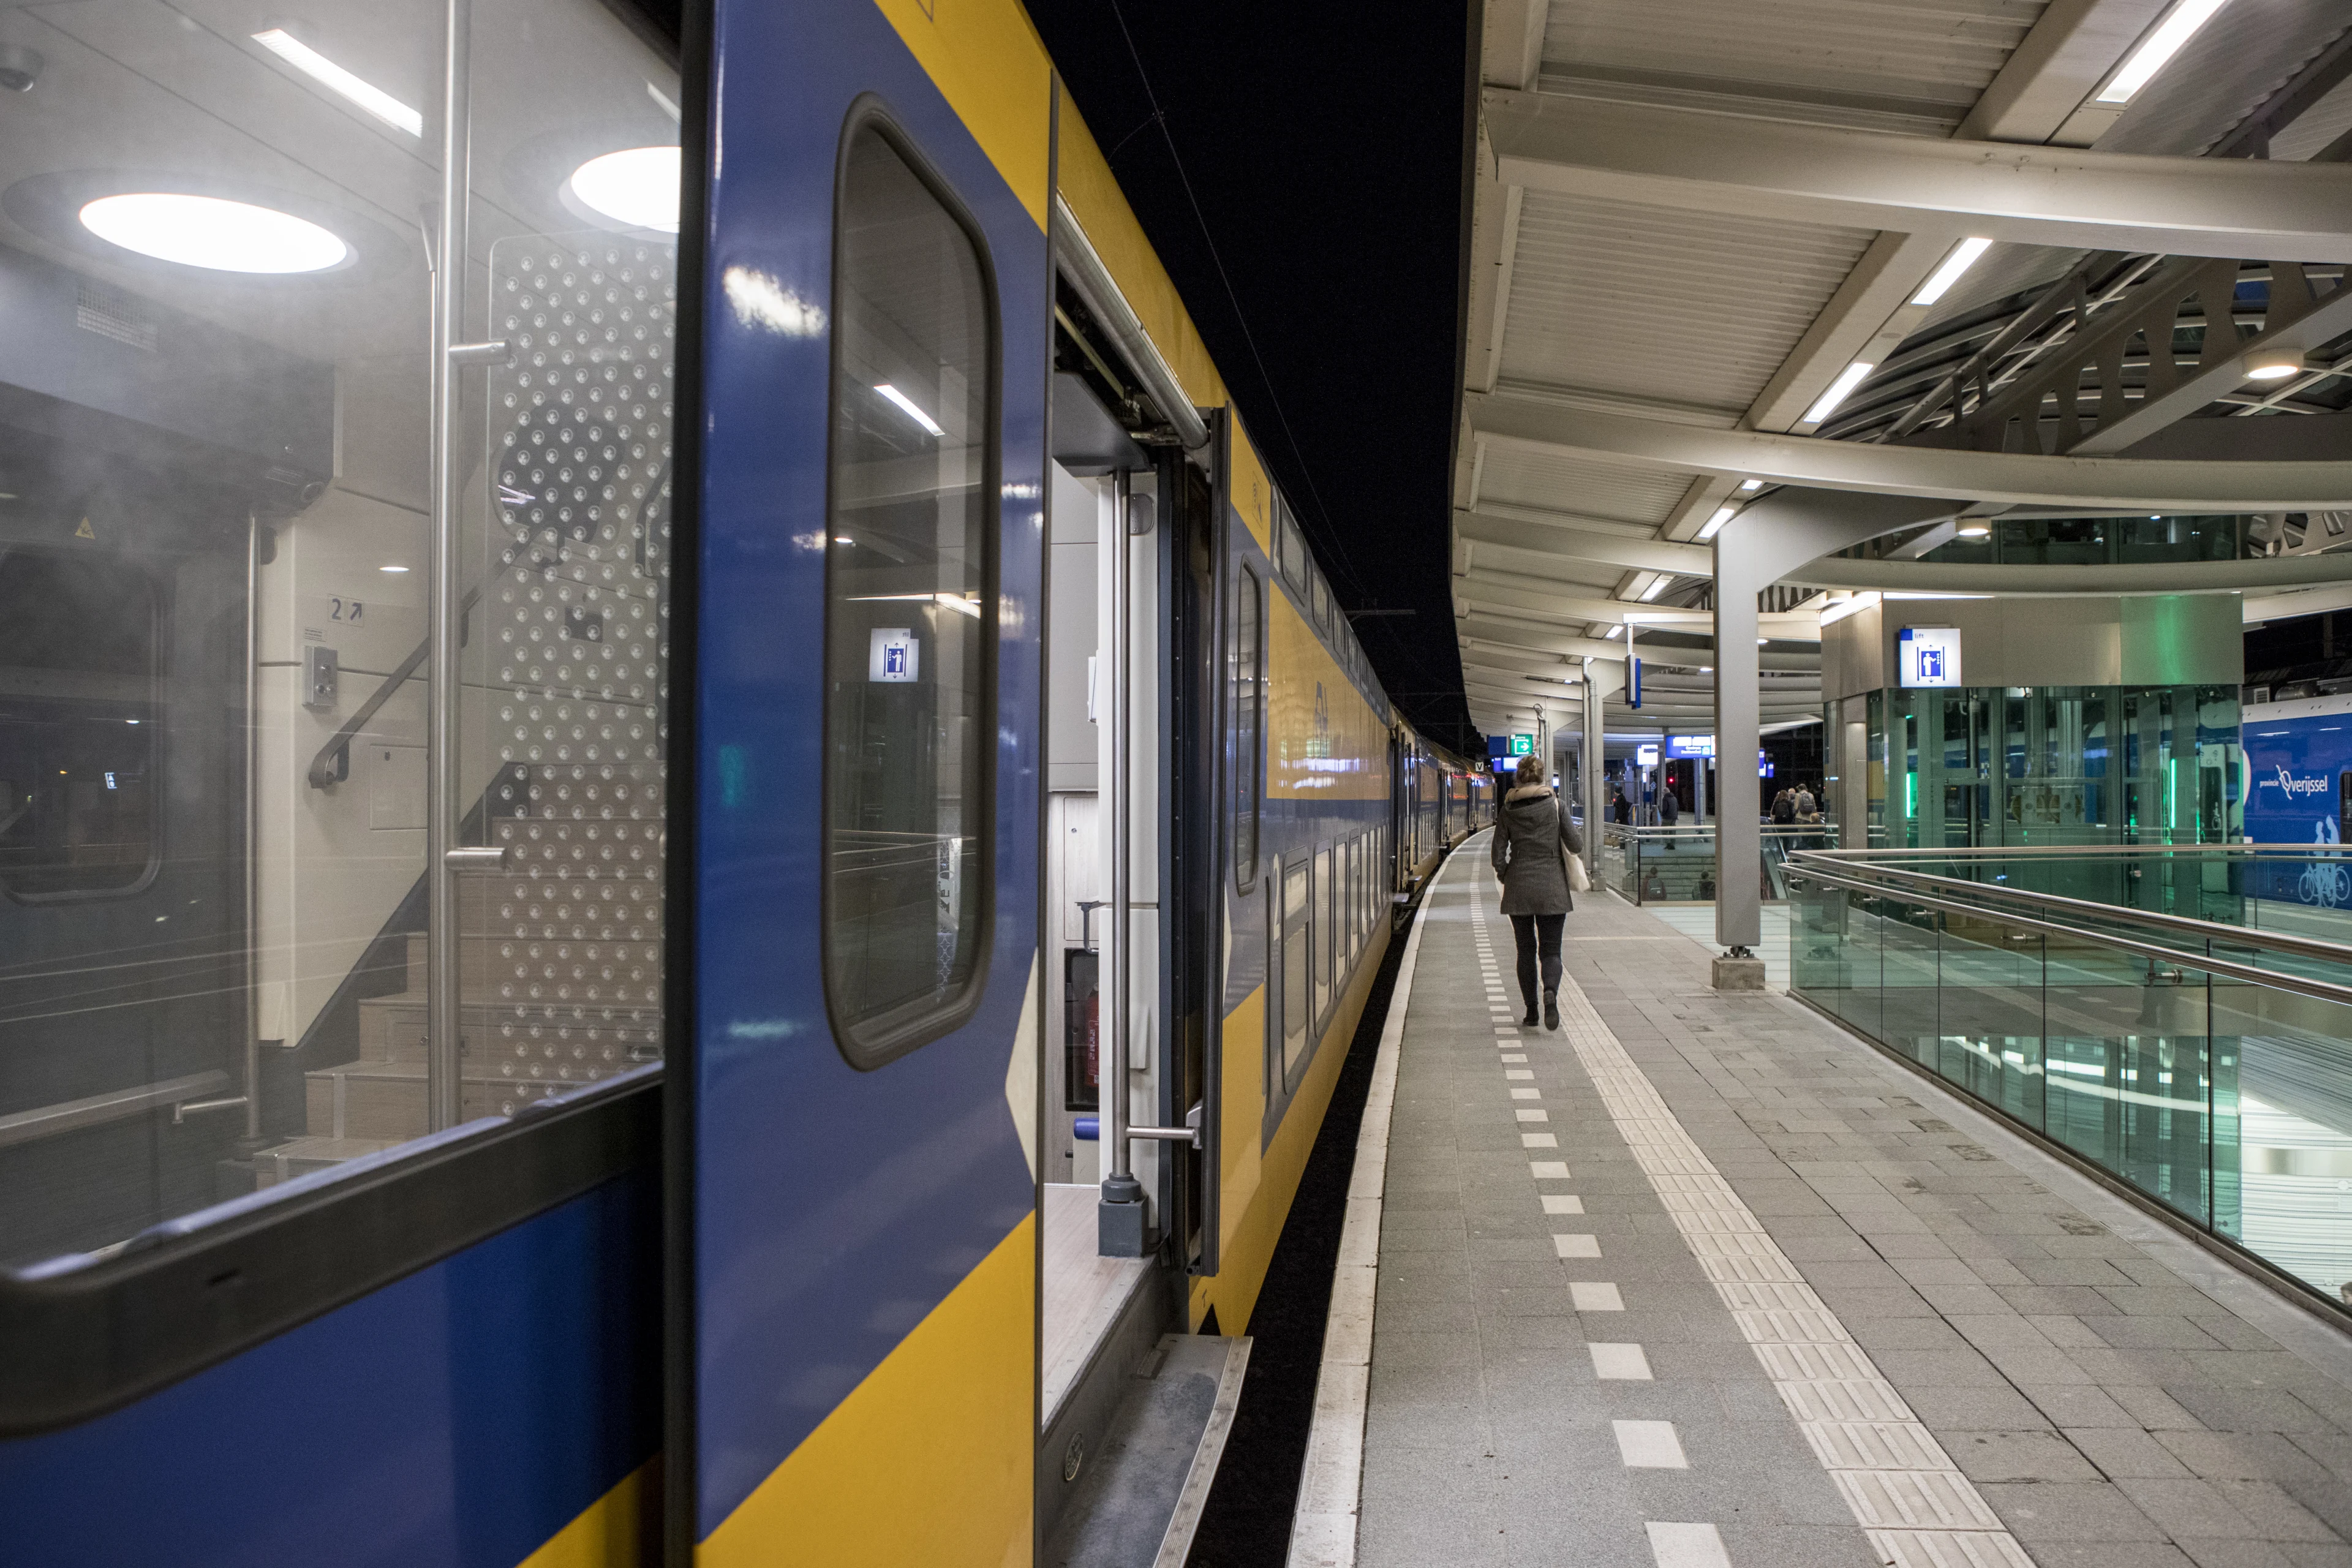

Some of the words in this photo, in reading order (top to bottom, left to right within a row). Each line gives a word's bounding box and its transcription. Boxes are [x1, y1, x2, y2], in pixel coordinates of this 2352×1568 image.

[331, 598, 342, 620] 2
[2259, 779, 2279, 788] provincie
[2275, 764, 2328, 800] Overijssel
